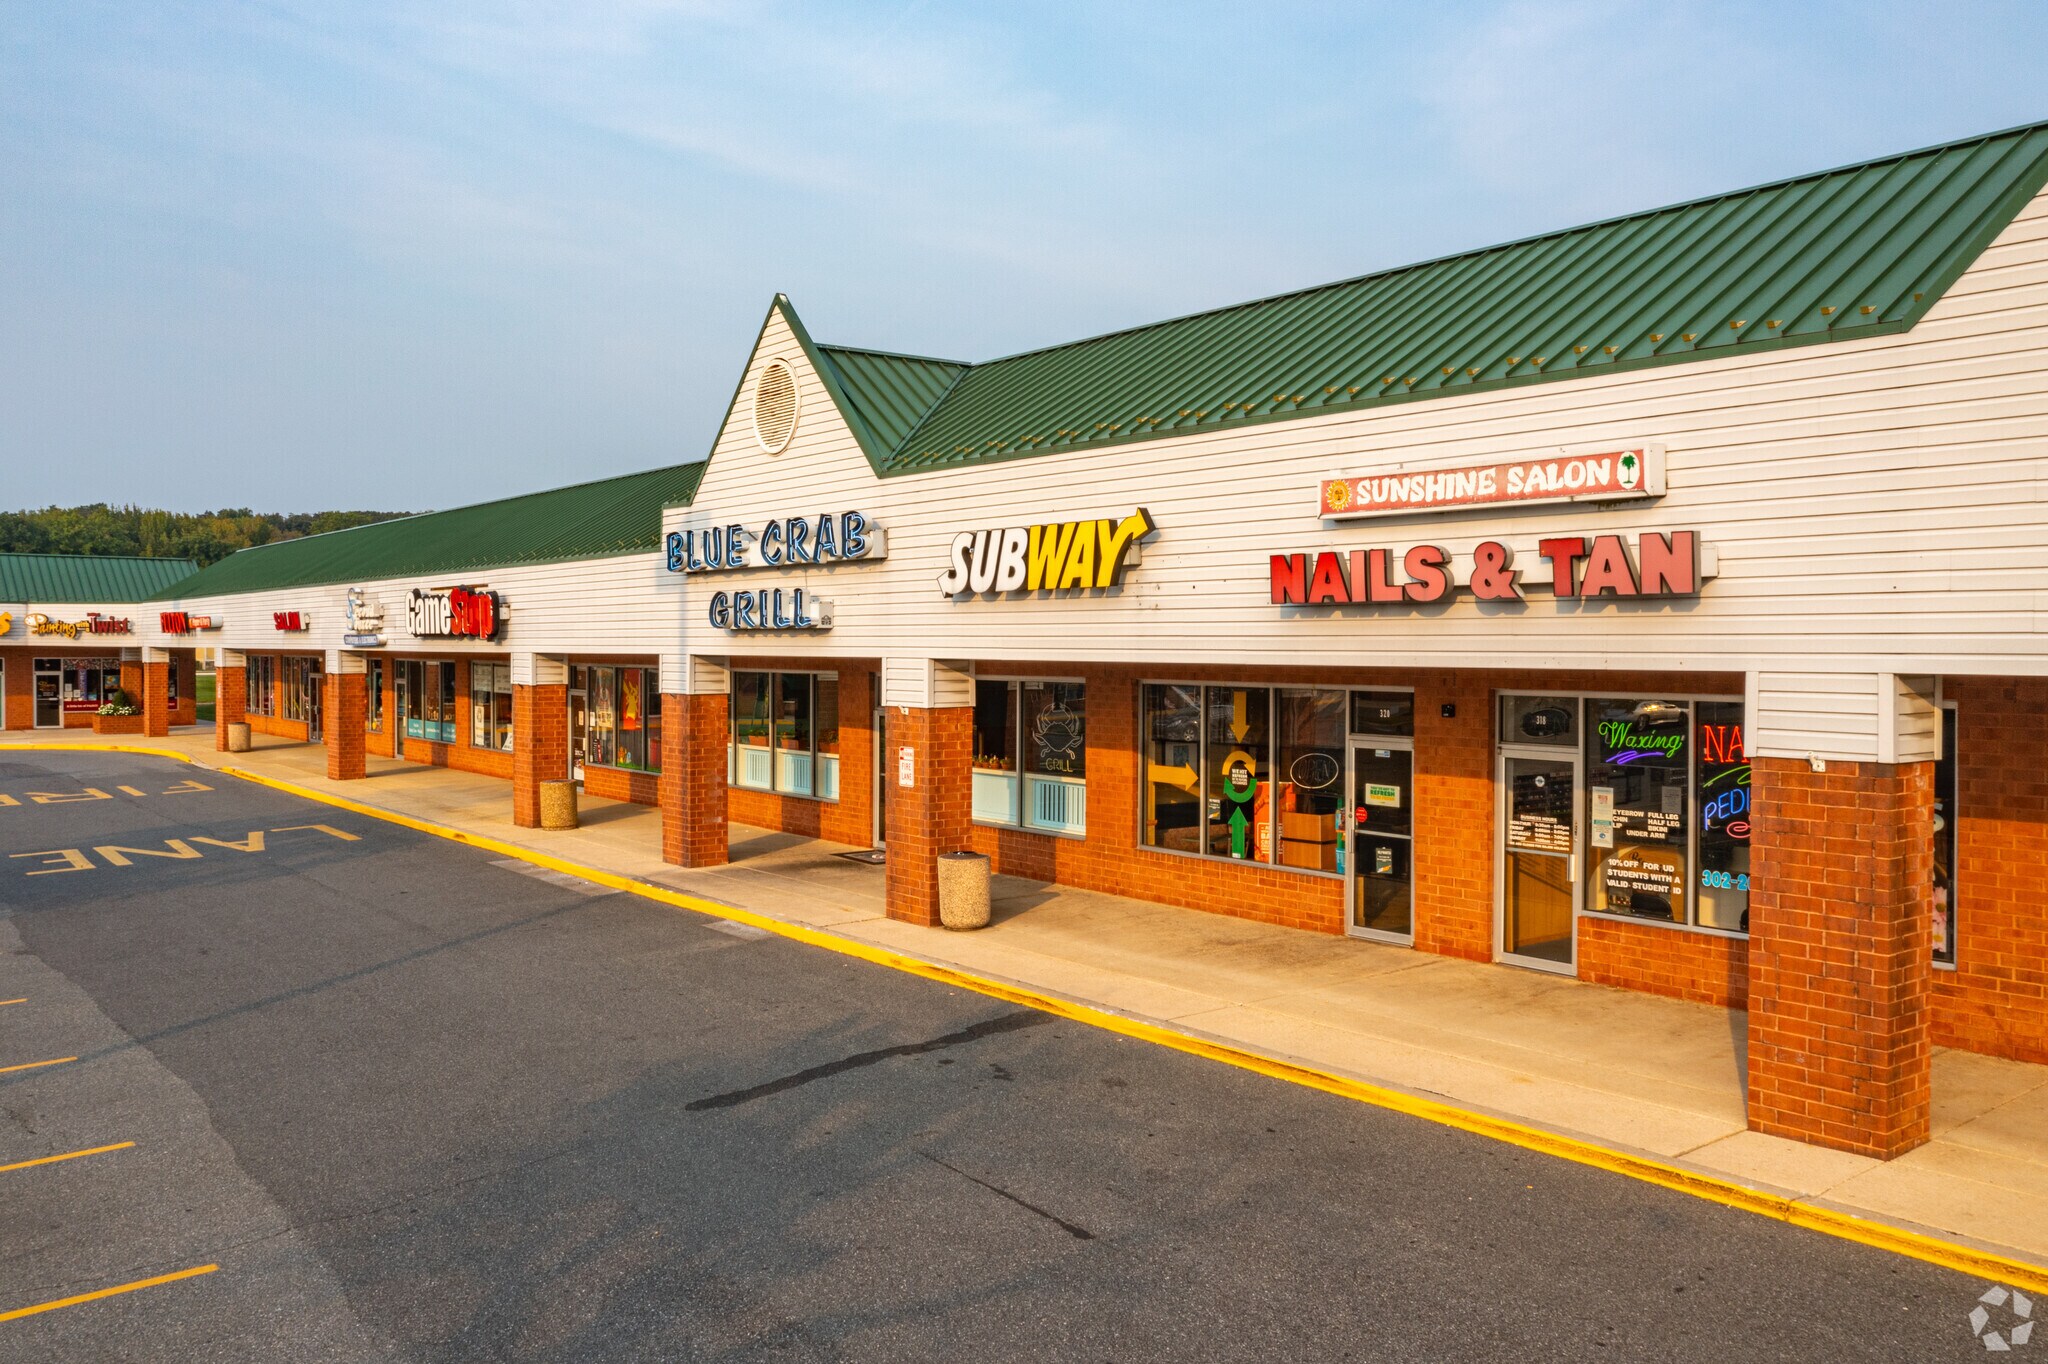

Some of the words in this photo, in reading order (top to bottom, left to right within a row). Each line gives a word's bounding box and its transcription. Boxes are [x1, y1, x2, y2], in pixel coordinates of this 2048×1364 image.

[1356, 467, 1496, 505] SUNSHINE
[1507, 457, 1610, 494] SALON
[666, 523, 746, 572] BLUE
[761, 510, 869, 566] CRAB
[937, 507, 1149, 598] SUBWAY
[1269, 544, 1449, 605] NAILS
[1470, 541, 1519, 600] &
[1539, 530, 1697, 598] TAN
[405, 586, 495, 639] GameStop
[709, 587, 813, 629] GRILL
[87, 612, 129, 634] Twist
[273, 612, 300, 631] SALON
[1379, 709, 1391, 718] 320
[1599, 722, 1682, 758] Waxing
[1703, 724, 1750, 763] NA
[1045, 758, 1074, 772] GRILL
[1613, 809, 1645, 818] EYEBROW
[1704, 787, 1750, 831] PEDI
[1626, 829, 1649, 838] UNDER
[1647, 825, 1668, 833] BIKINI
[9, 824, 363, 876] LANE
[1607, 869, 1649, 880] STUDENTS
[1650, 873, 1672, 883] WITH
[1674, 876, 1681, 884] A
[1623, 860, 1639, 868] OFF
[1643, 862, 1660, 871] FOR
[1632, 882, 1669, 893] STUDENT
[1672, 887, 1682, 895] ID
[1701, 869, 1750, 891] 302-2
